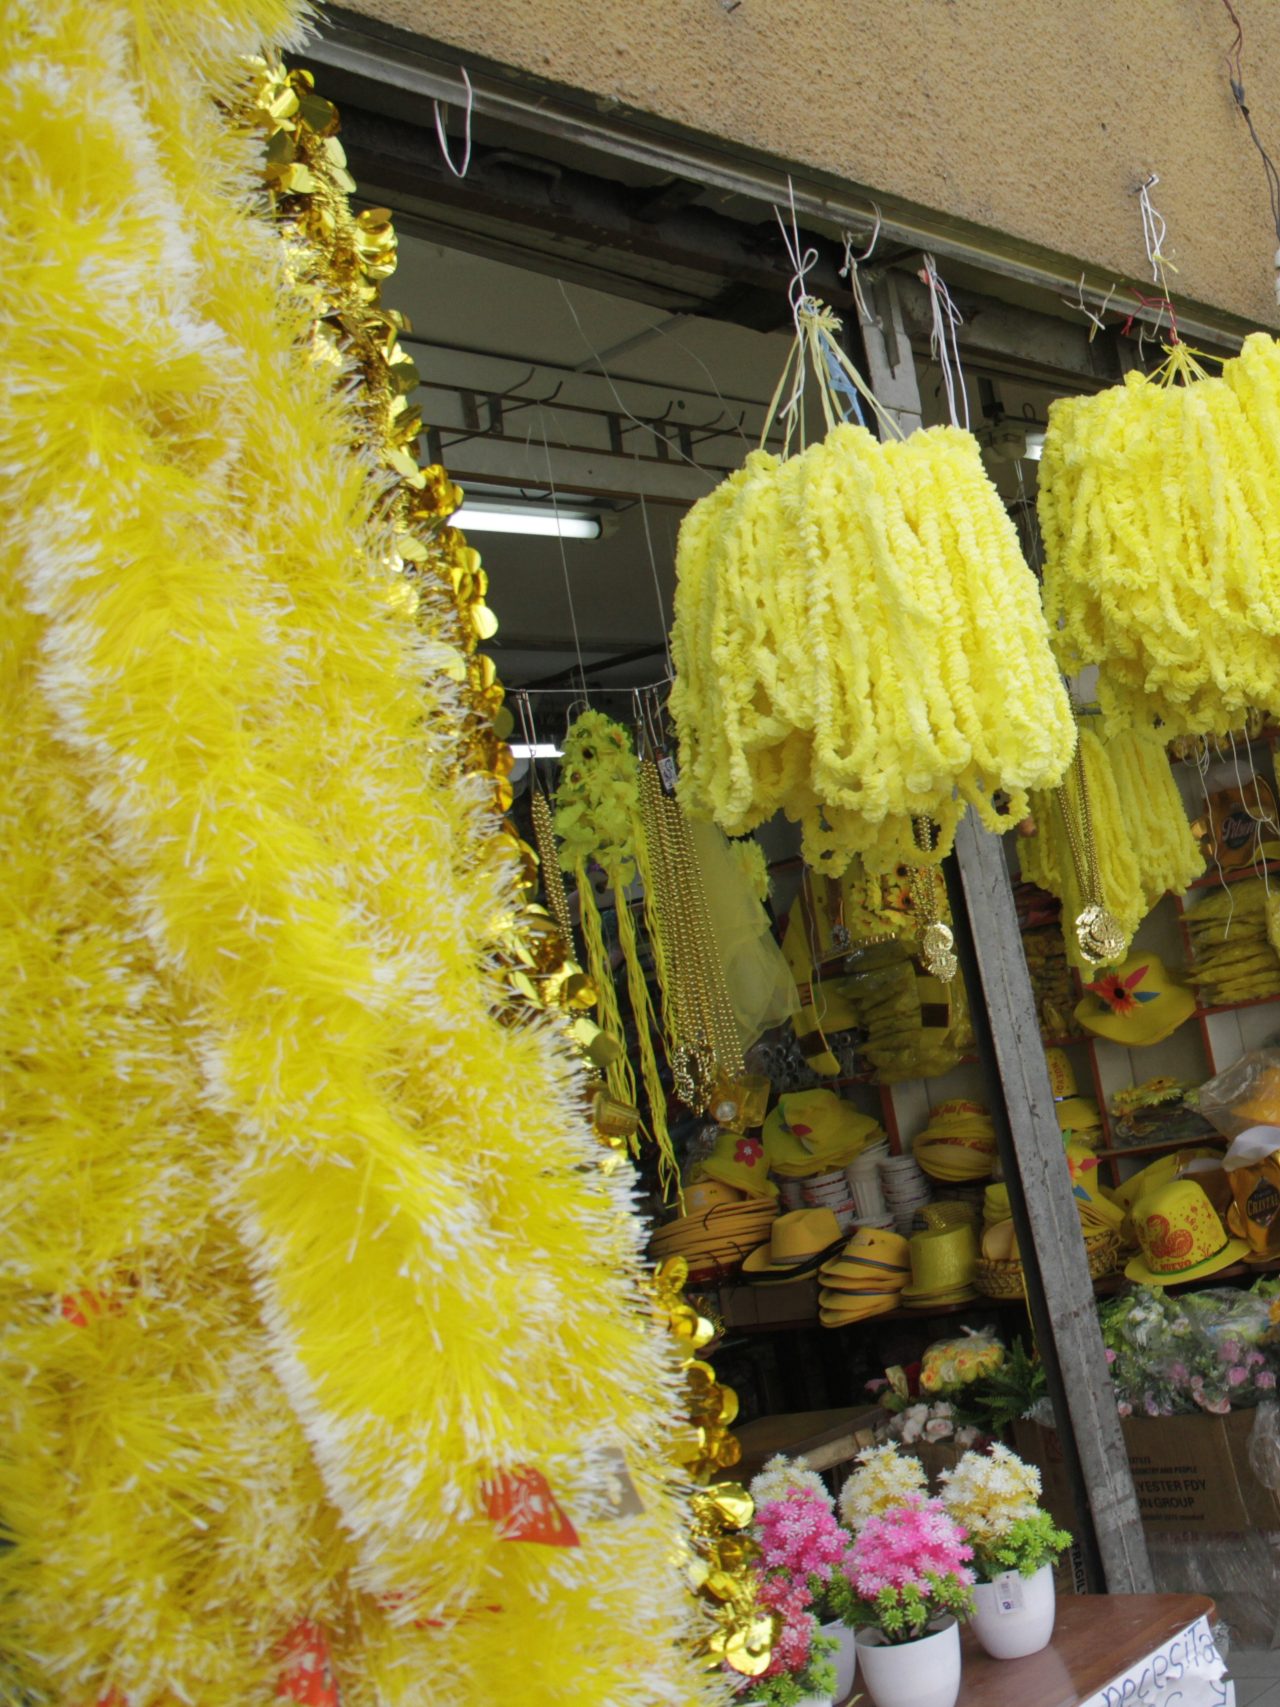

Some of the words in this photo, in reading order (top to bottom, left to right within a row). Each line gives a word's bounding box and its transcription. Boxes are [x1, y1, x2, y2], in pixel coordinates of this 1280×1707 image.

[1183, 1479, 1206, 1491] FDY
[1153, 1497, 1195, 1508] GROUP
[1071, 1543, 1087, 1595] FRAGIL
